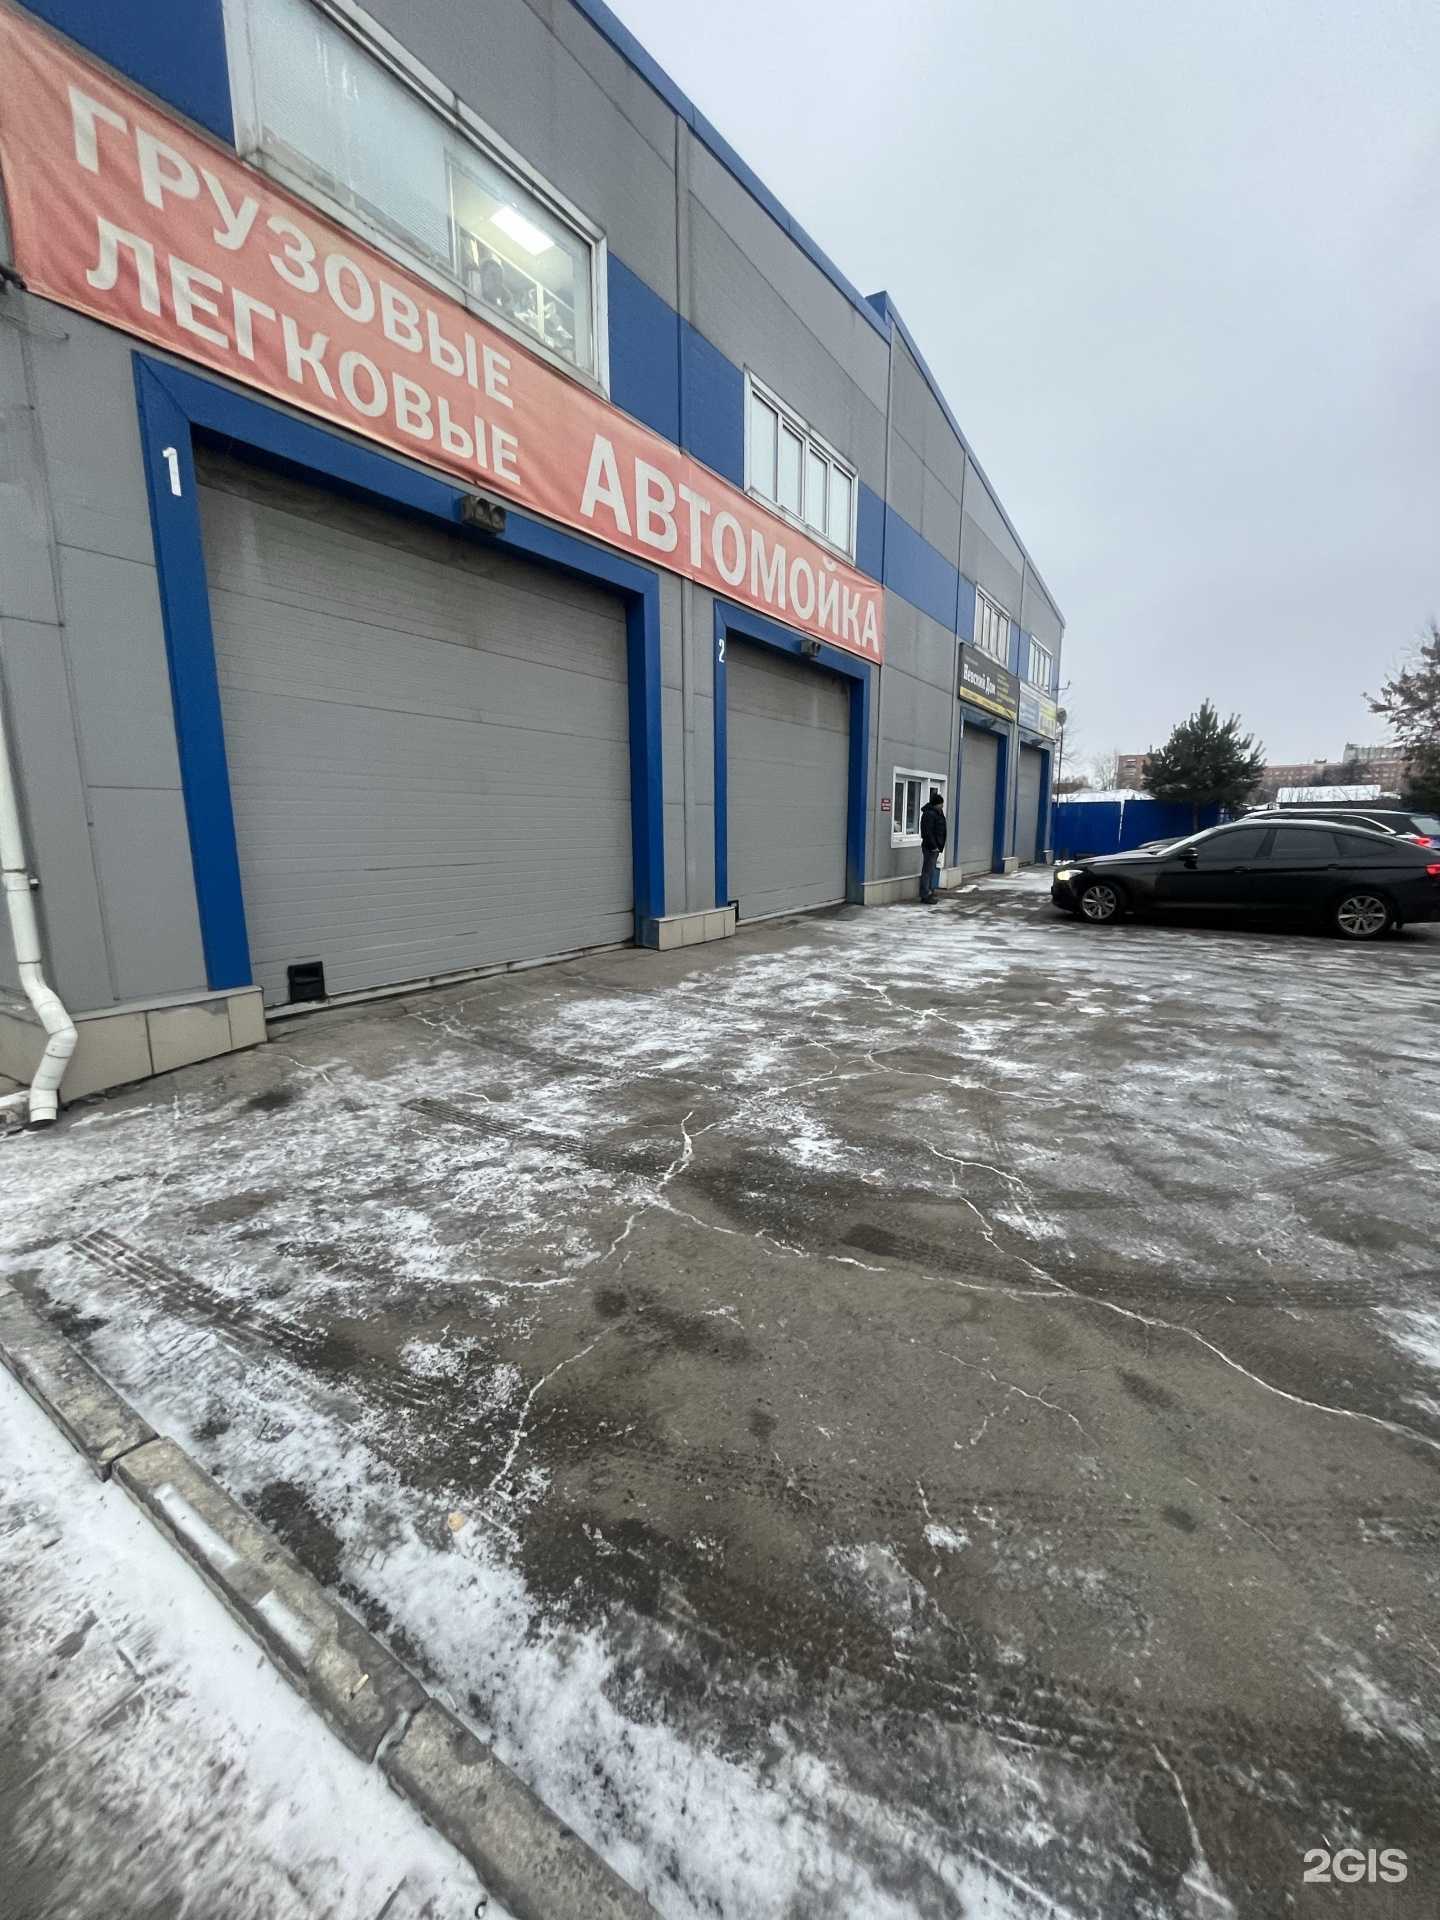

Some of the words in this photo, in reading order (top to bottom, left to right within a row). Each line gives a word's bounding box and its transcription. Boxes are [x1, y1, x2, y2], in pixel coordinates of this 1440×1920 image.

[69, 86, 514, 408] ГРУЗОВЫЕ
[87, 215, 521, 485] ЛЕГКОВЫЕ
[162, 446, 182, 497] 1
[580, 433, 880, 653] АВТОМОЙКА
[718, 638, 726, 663] 2
